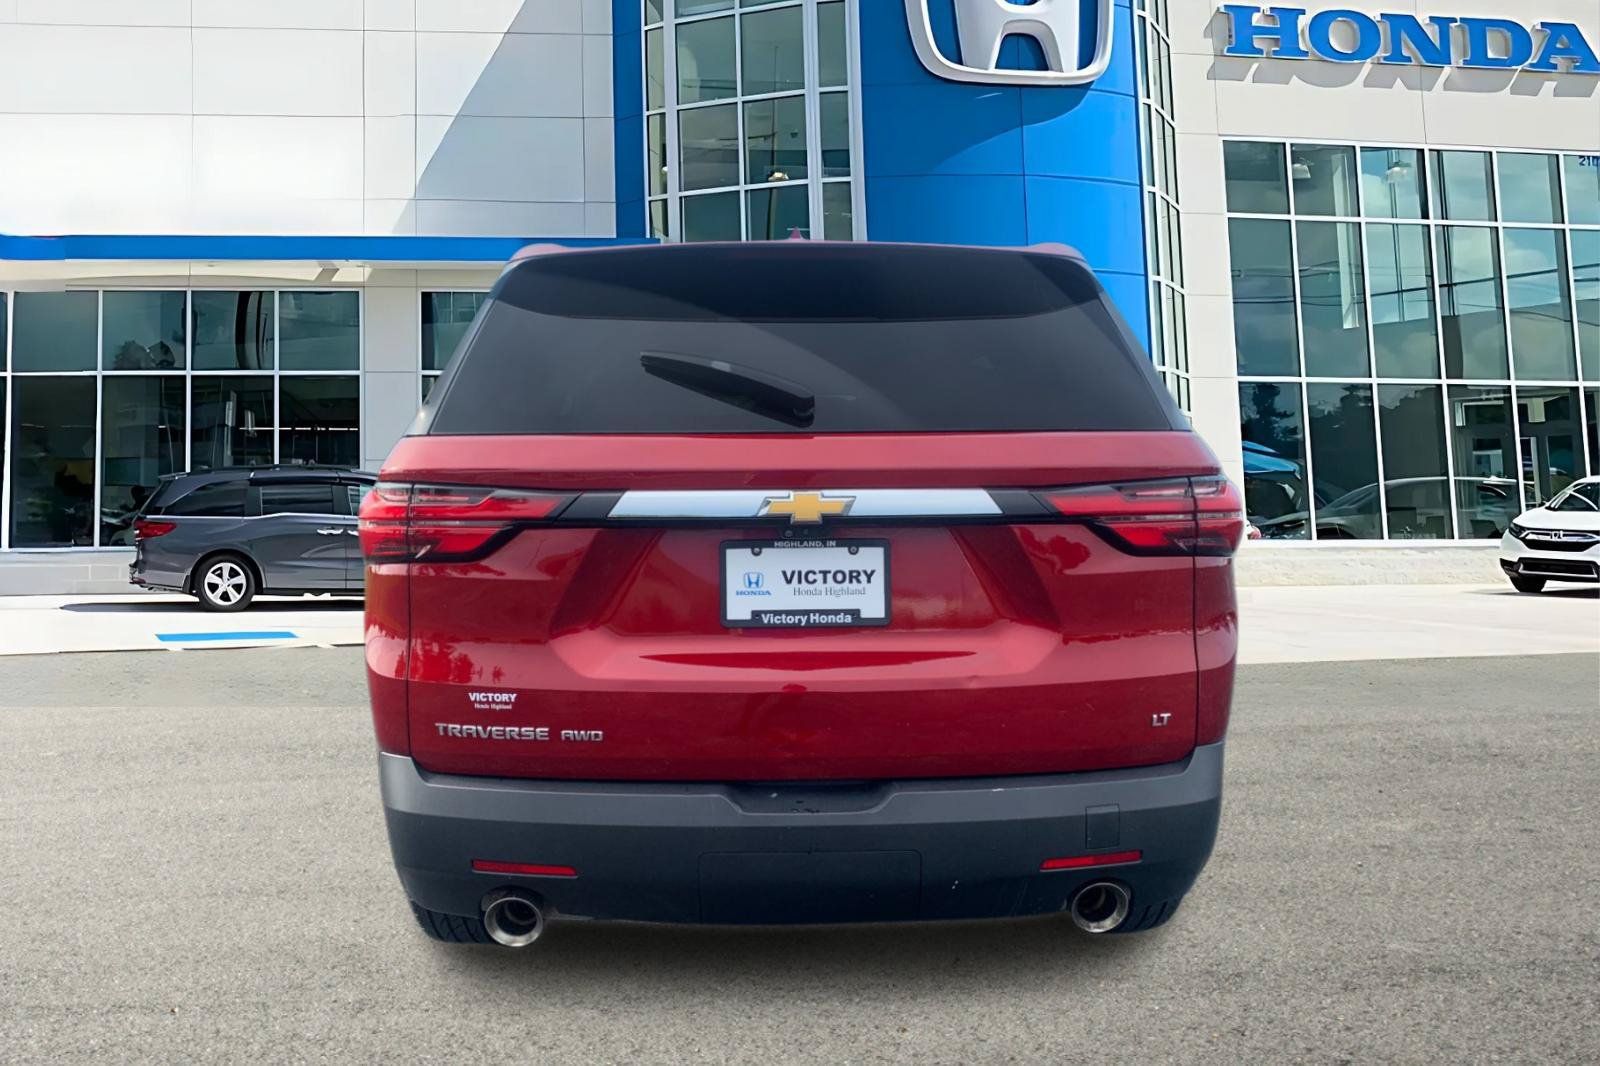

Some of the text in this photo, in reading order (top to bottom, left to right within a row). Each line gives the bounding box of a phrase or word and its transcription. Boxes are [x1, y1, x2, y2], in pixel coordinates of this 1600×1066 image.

[1223, 4, 1600, 73] HONDA
[826, 540, 837, 548] IN
[781, 569, 876, 585] VICTORY
[793, 586, 866, 598] Honda Highland
[761, 612, 852, 626] Victory Honda
[468, 692, 517, 702] VICTORY
[1152, 713, 1171, 727] LT
[435, 723, 604, 742] TRAVERSE AWD
